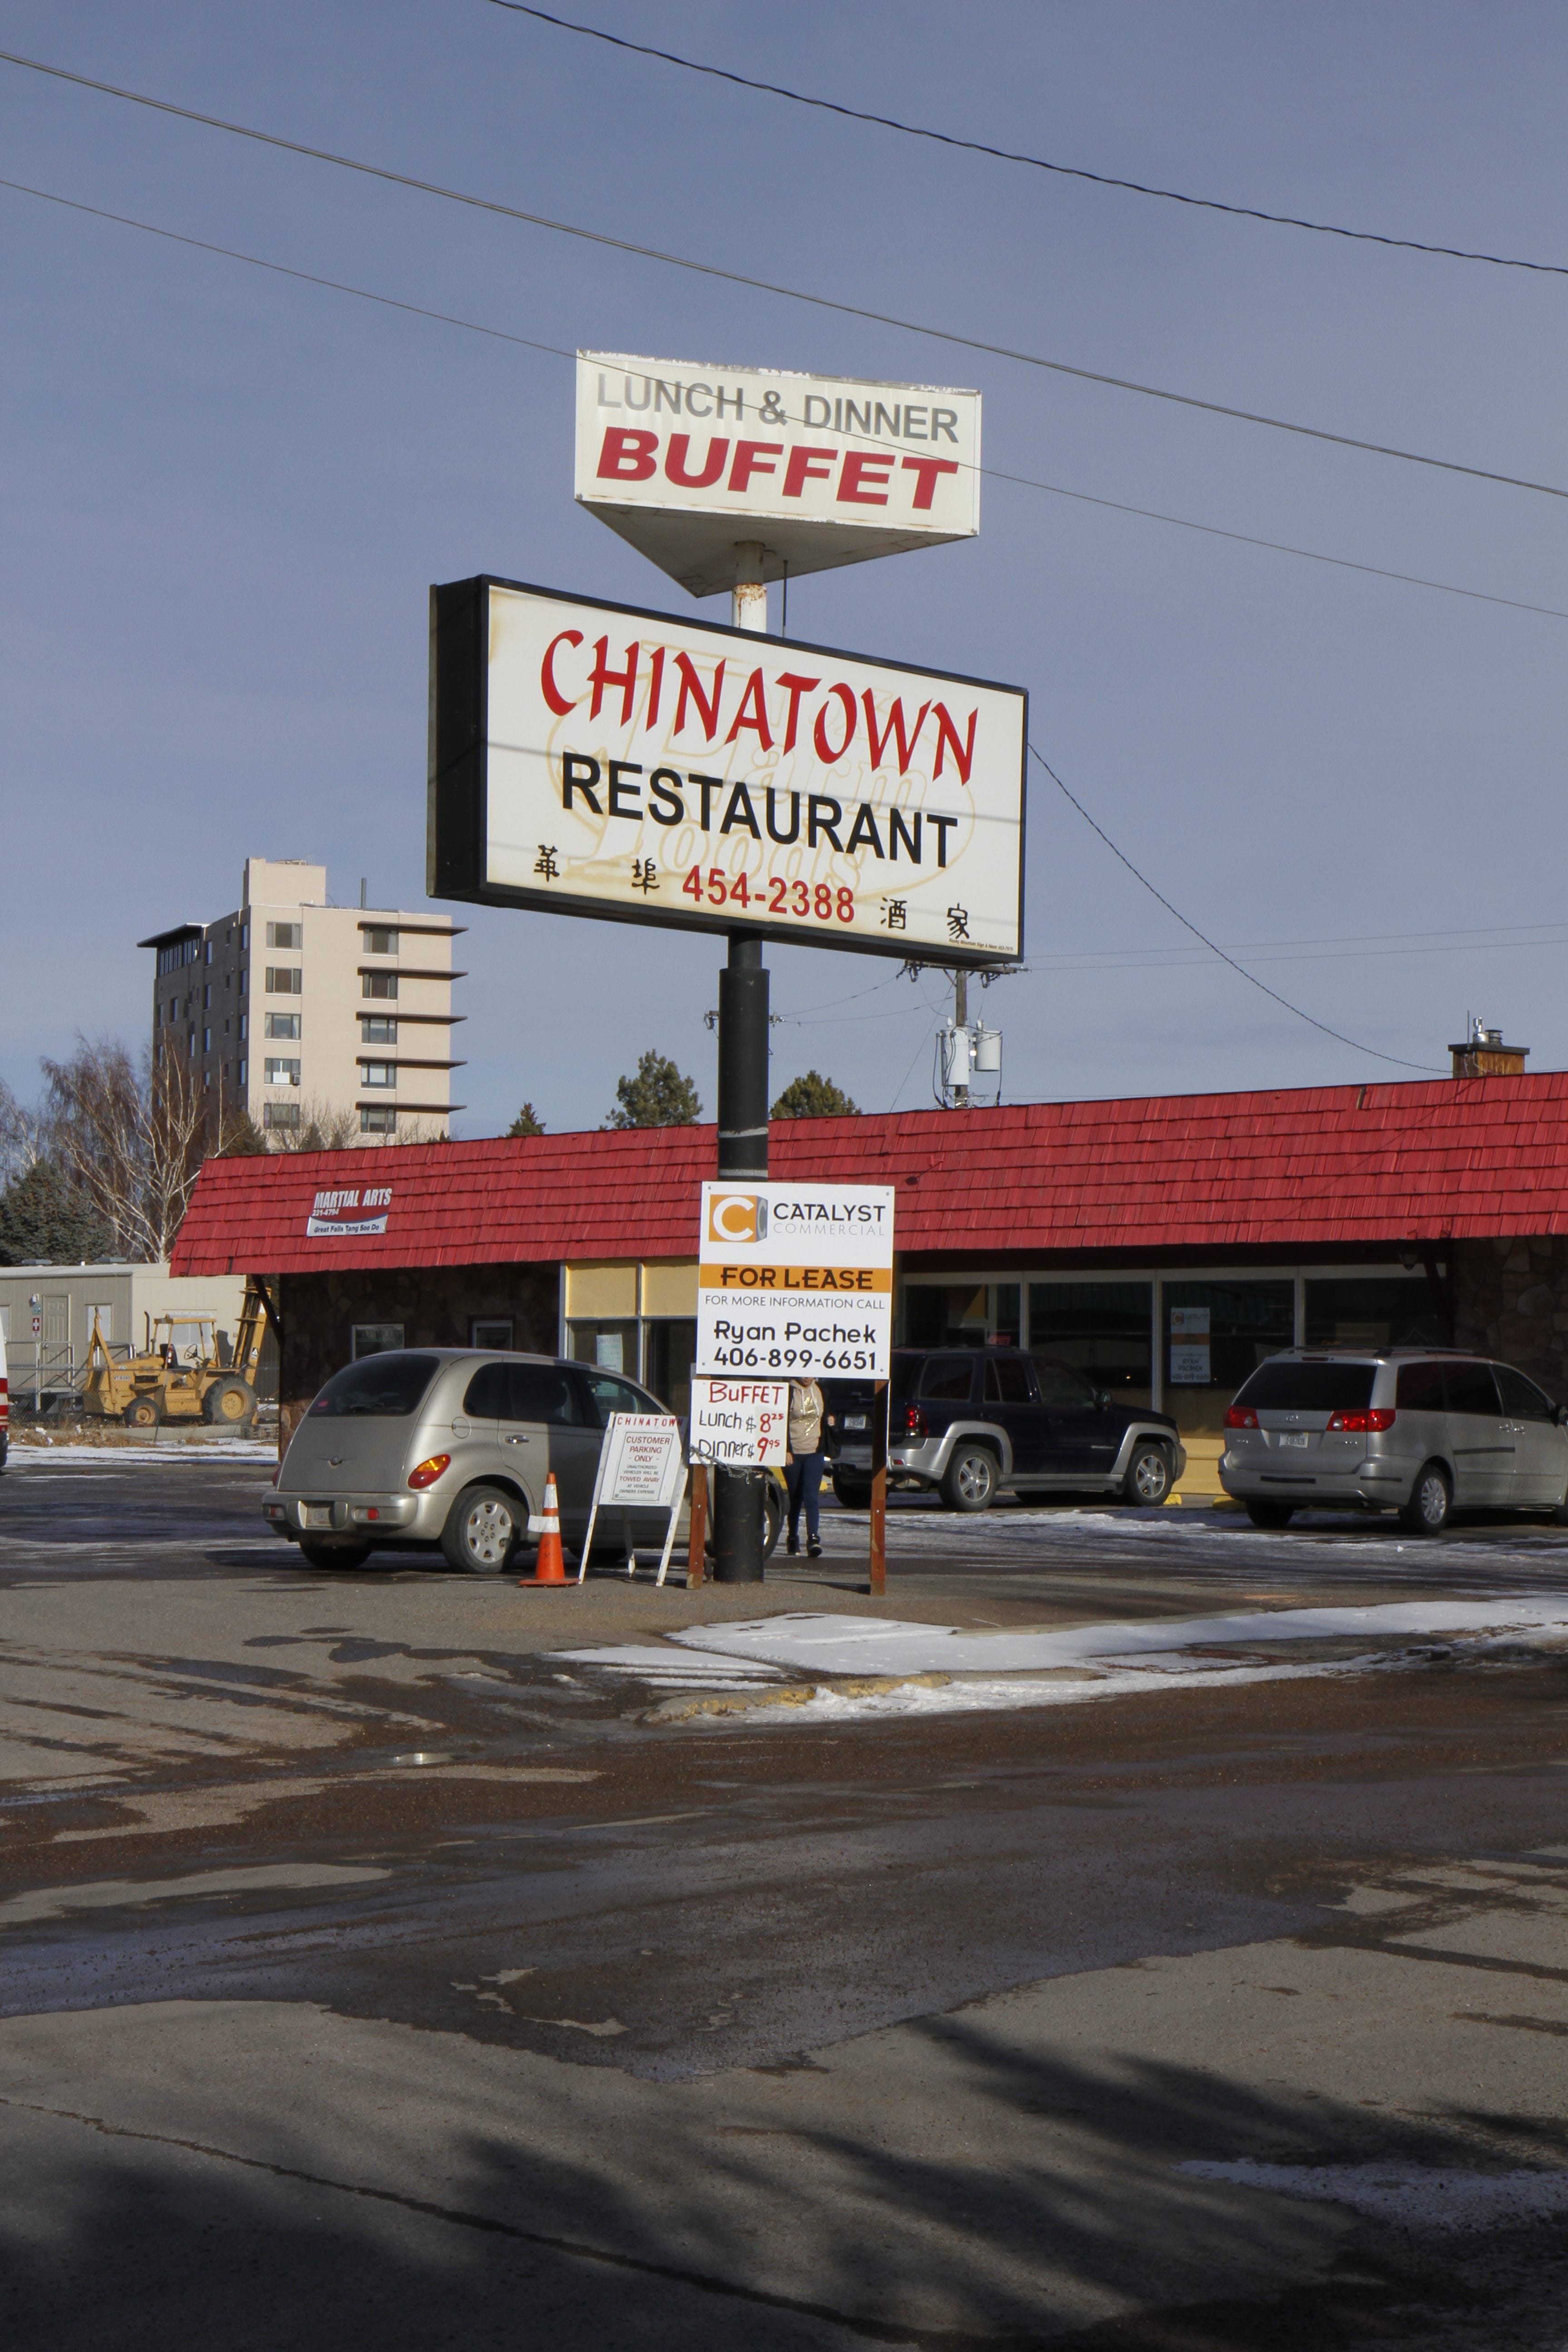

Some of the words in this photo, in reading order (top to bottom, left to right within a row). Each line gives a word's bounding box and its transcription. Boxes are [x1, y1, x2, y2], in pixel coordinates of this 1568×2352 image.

[597, 373, 744, 421] LUNCH
[759, 390, 787, 426] &
[804, 395, 958, 443] DINNER
[597, 426, 959, 510] BUFFET
[540, 630, 978, 784] CHINATOWN
[563, 752, 957, 868] RESTAURANT
[682, 865, 855, 923] 454-2388
[314, 1190, 360, 1209] MARTIAL
[362, 1188, 392, 1206] ARTS
[312, 1208, 339, 1216] 231-4794
[773, 1202, 886, 1222] CATALYST
[773, 1223, 885, 1236] COMMERCIAL
[720, 1267, 776, 1288] FOR
[784, 1269, 873, 1289] LEASE
[705, 1295, 729, 1305] FOR
[731, 1296, 766, 1307] MORE
[769, 1297, 854, 1308] INFORMATION
[857, 1299, 884, 1309] CALL
[714, 1320, 775, 1344] Ryan
[784, 1323, 876, 1344] Pachek
[714, 1347, 875, 1370] 406-899-6651
[617, 1416, 683, 1426] CHINATOWN
[699, 1410, 742, 1429] Lunch
[626, 1436, 670, 1444] CUSTOMER
